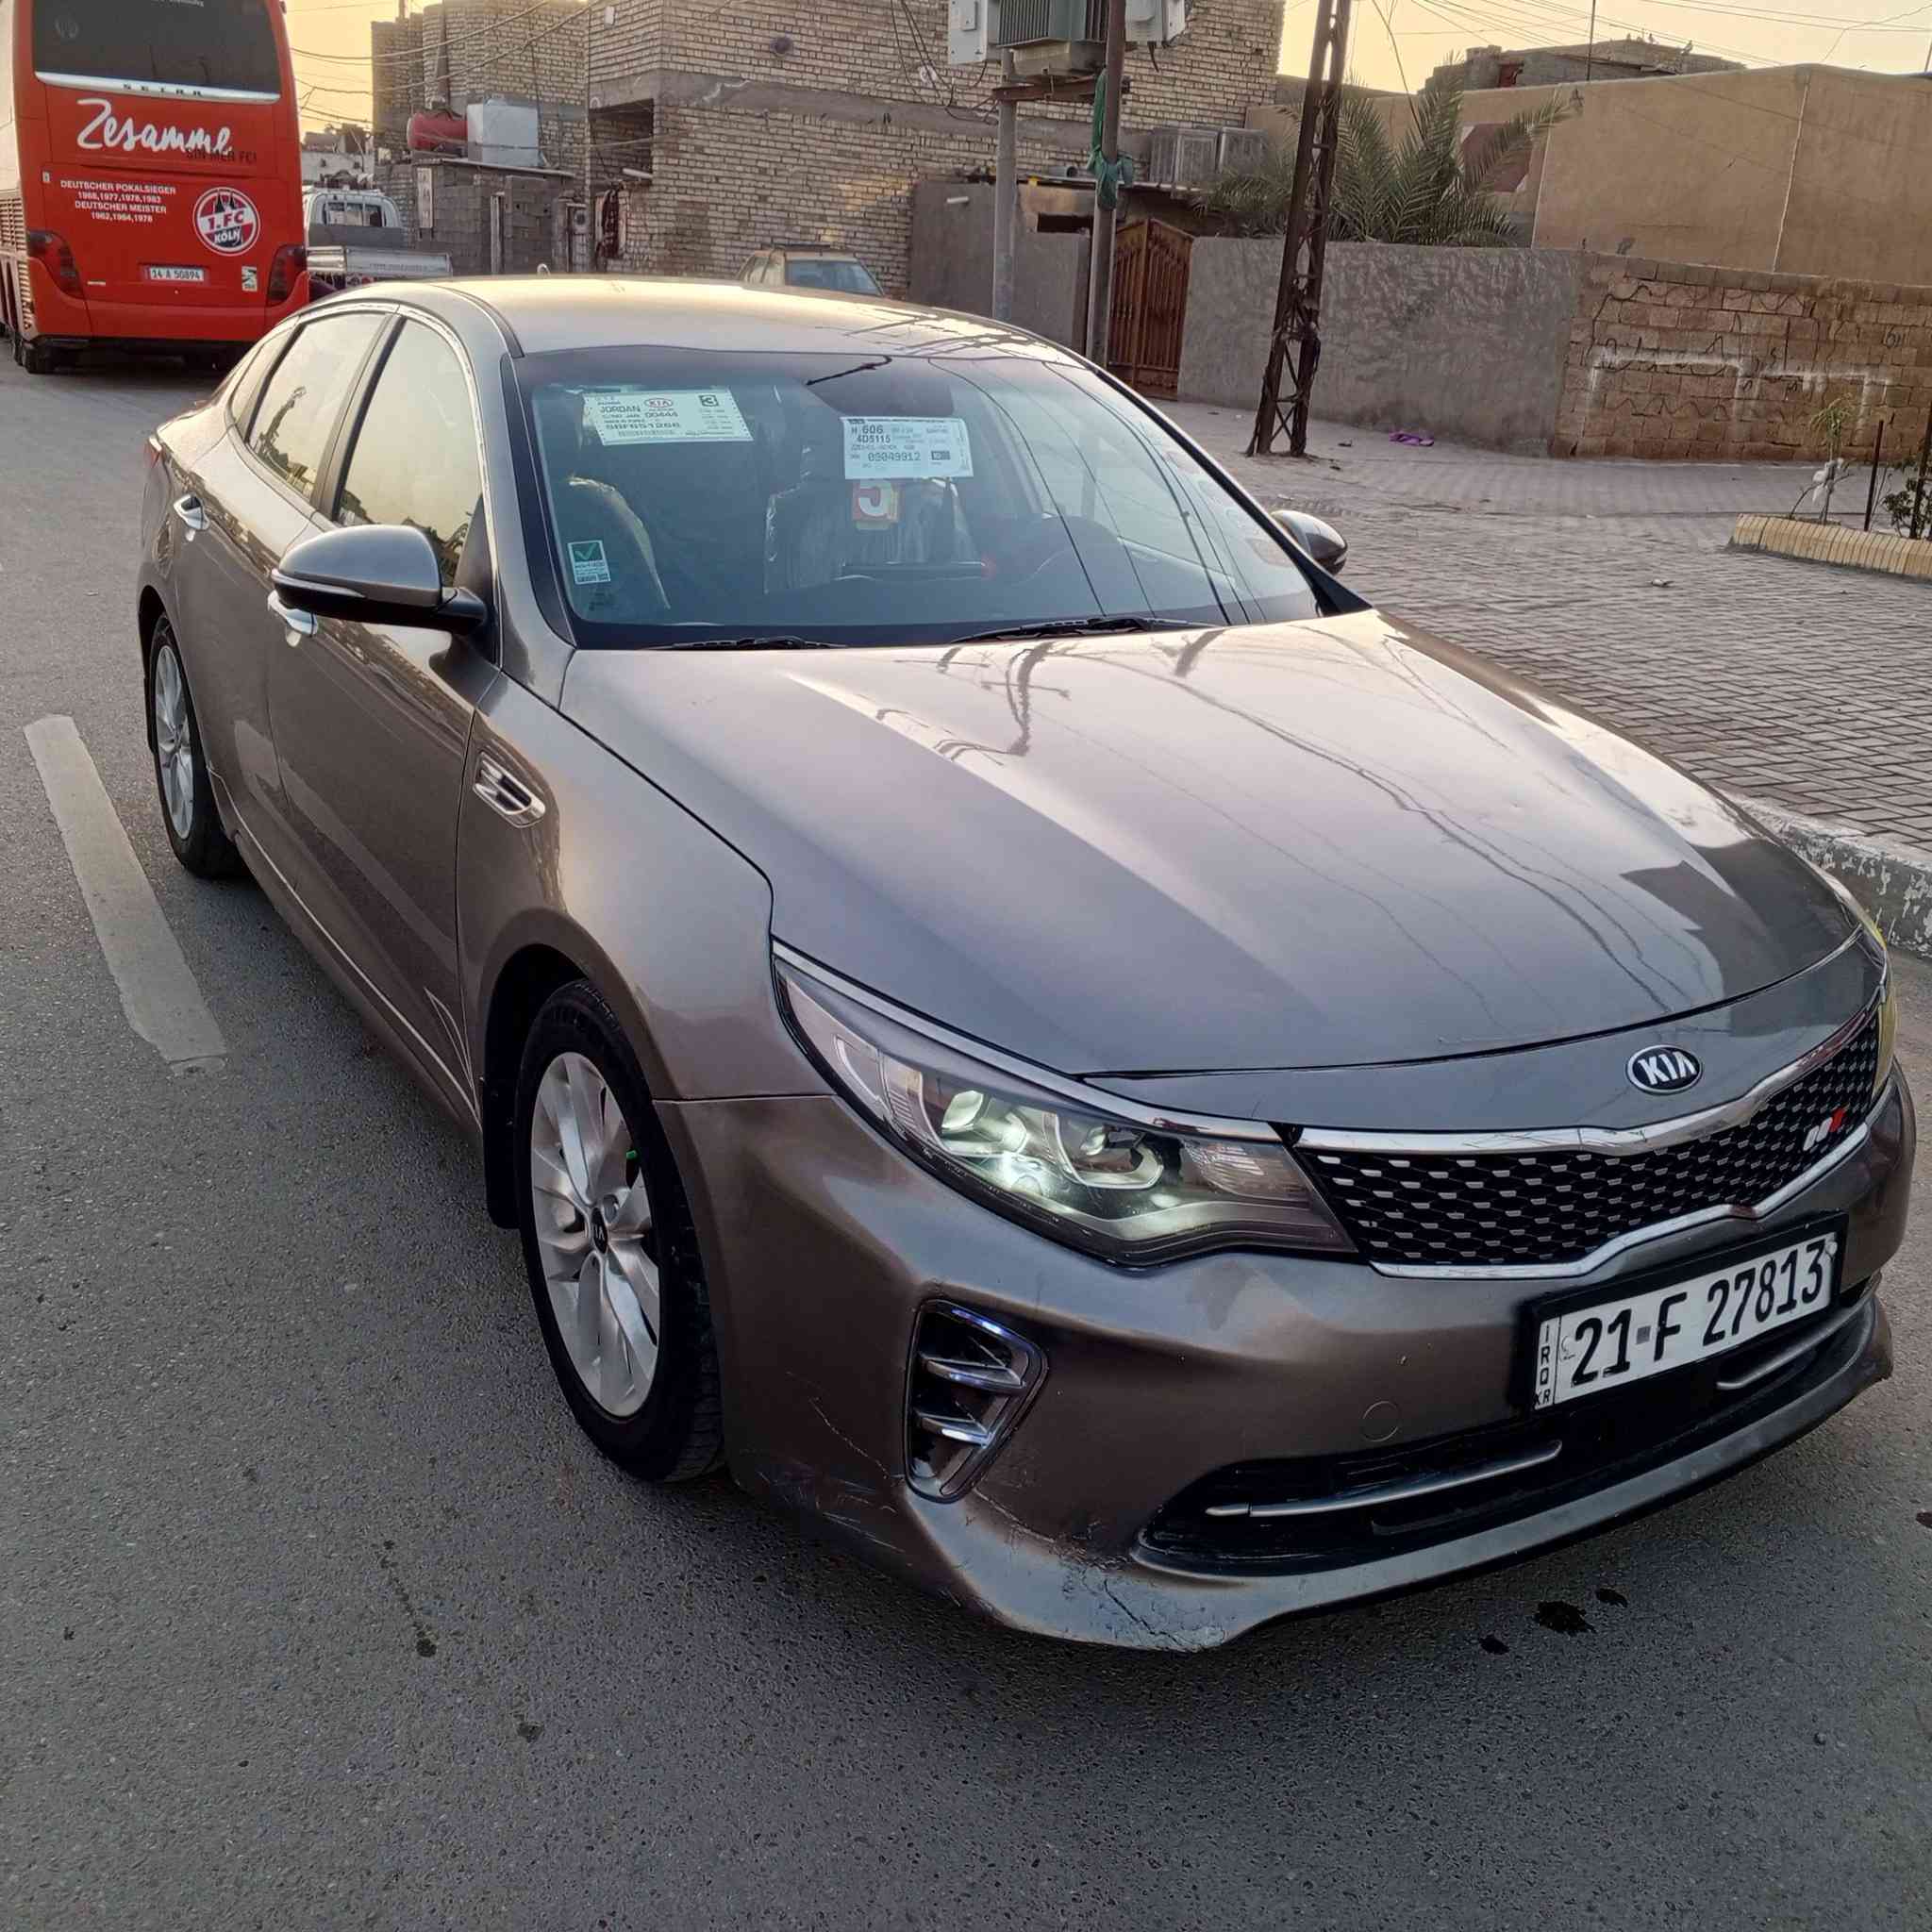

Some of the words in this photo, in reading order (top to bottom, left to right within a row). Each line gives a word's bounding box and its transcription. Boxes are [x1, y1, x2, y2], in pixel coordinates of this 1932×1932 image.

[75, 97, 233, 156] Zesamme
[60, 179, 114, 192] DEUTSCHER
[116, 182, 176, 194] POKALSIEGER
[75, 200, 128, 210] DEUTSCHER
[129, 203, 167, 214] MEISTER
[599, 405, 641, 413] JORDAN
[862, 425, 884, 435] 606
[1638, 1050, 1697, 1086] KIA
[1570, 1308, 1632, 1387] 21
[1654, 1291, 1688, 1362] F
[1702, 1239, 1828, 1347] 27813
[1539, 1323, 1551, 1387] IRQ
